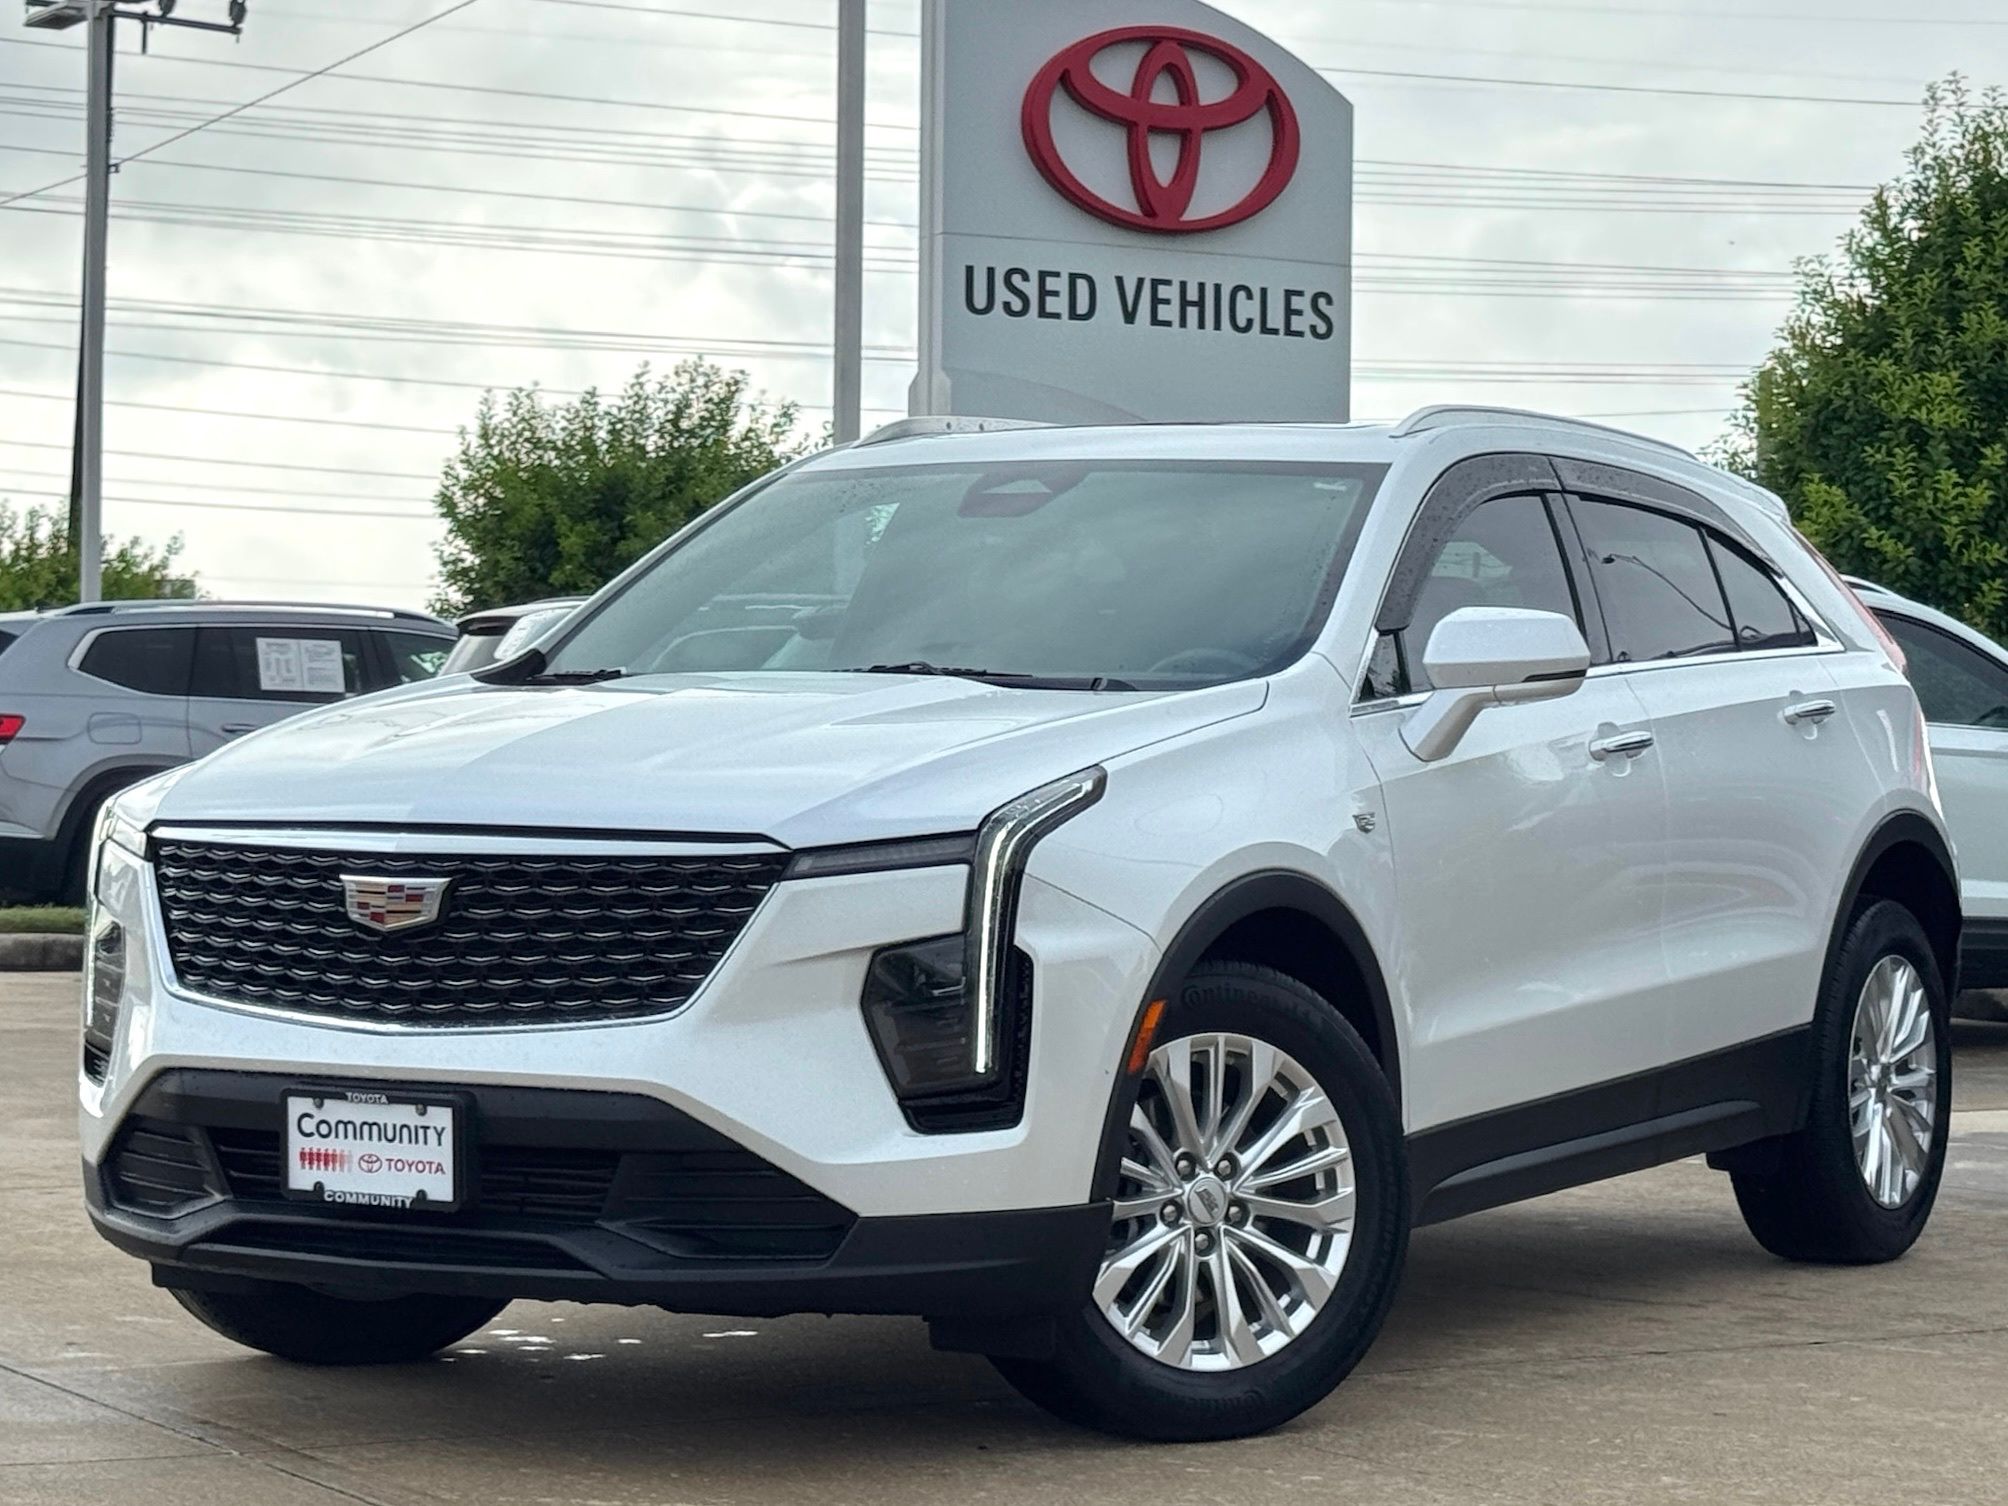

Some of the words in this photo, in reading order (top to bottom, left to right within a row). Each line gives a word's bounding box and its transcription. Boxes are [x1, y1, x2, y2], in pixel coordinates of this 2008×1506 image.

[964, 264, 1098, 322] USED
[1114, 275, 1335, 341] VEHICLES
[345, 1091, 389, 1105] TOYOTA
[386, 1158, 446, 1176] TOYOTA
[323, 1189, 414, 1209] COMMUNITY
